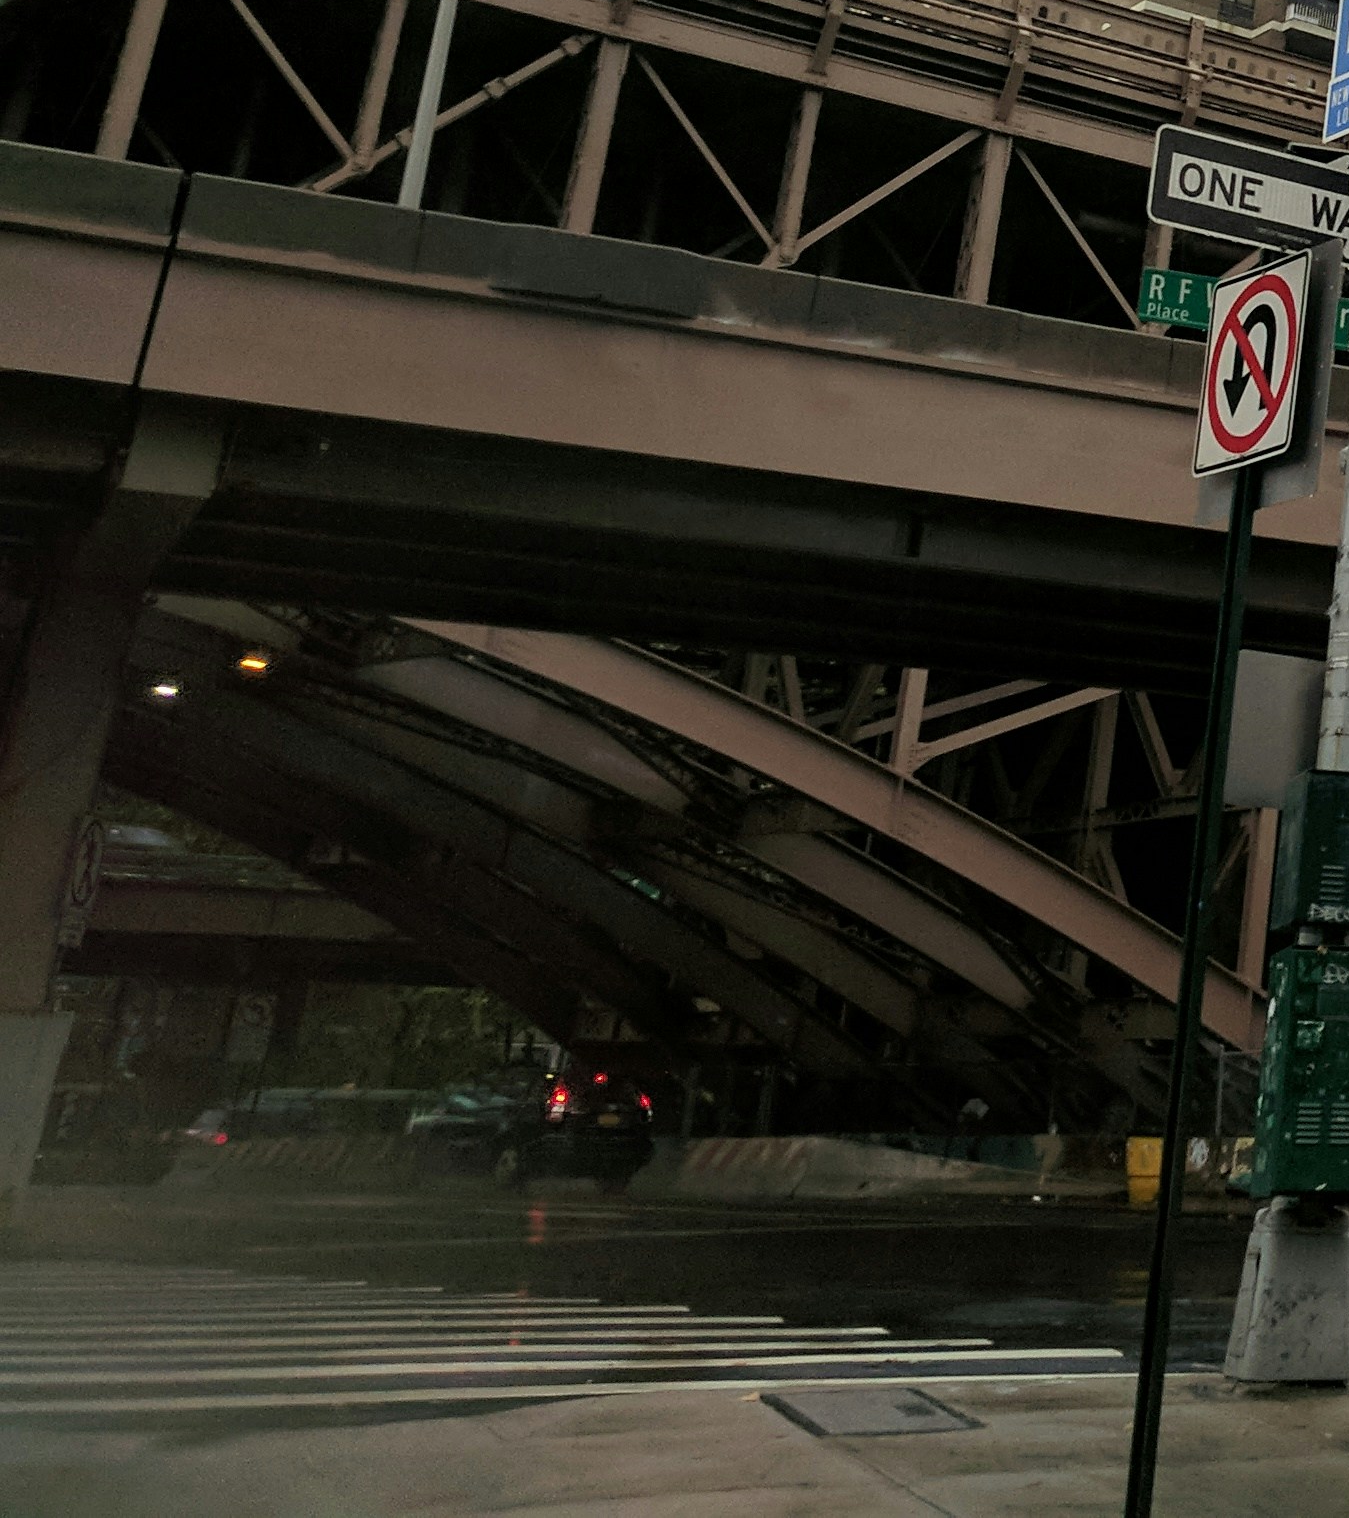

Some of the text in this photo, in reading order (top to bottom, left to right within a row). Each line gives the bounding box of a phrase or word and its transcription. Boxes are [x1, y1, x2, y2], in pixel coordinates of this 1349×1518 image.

[1179, 162, 1264, 213] ONE
[1149, 274, 1165, 300] R
[1179, 278, 1193, 304] F
[1146, 302, 1190, 322] Place
